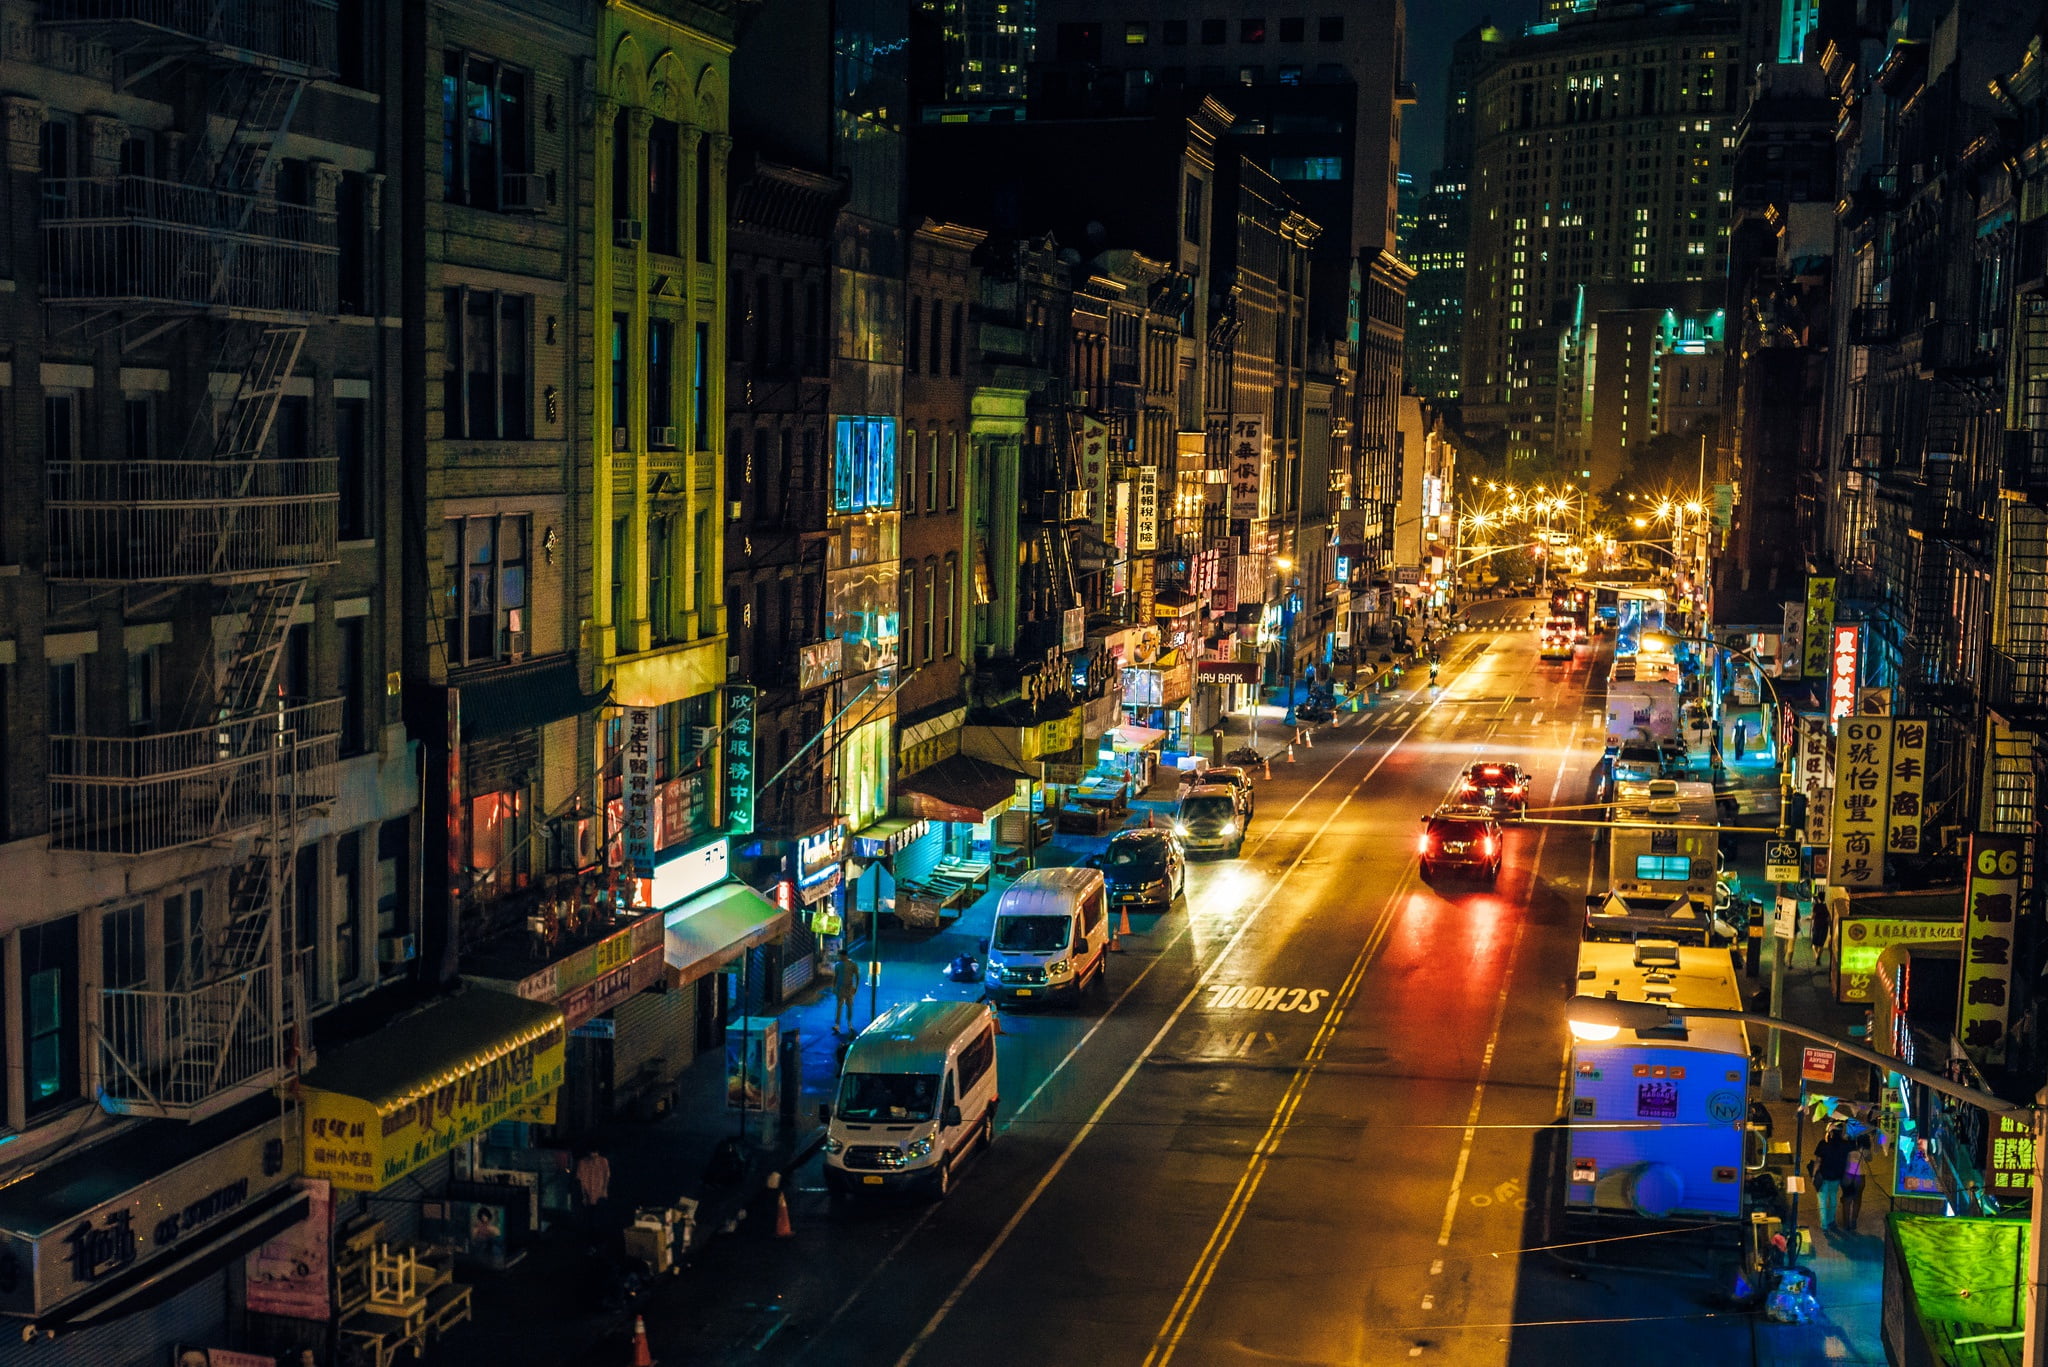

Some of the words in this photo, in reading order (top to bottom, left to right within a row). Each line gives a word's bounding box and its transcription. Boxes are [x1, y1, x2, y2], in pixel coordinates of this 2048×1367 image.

[1218, 673, 1243, 684] BANK
[1977, 849, 2018, 876] 66
[1206, 984, 1330, 1013] SCHOOL
